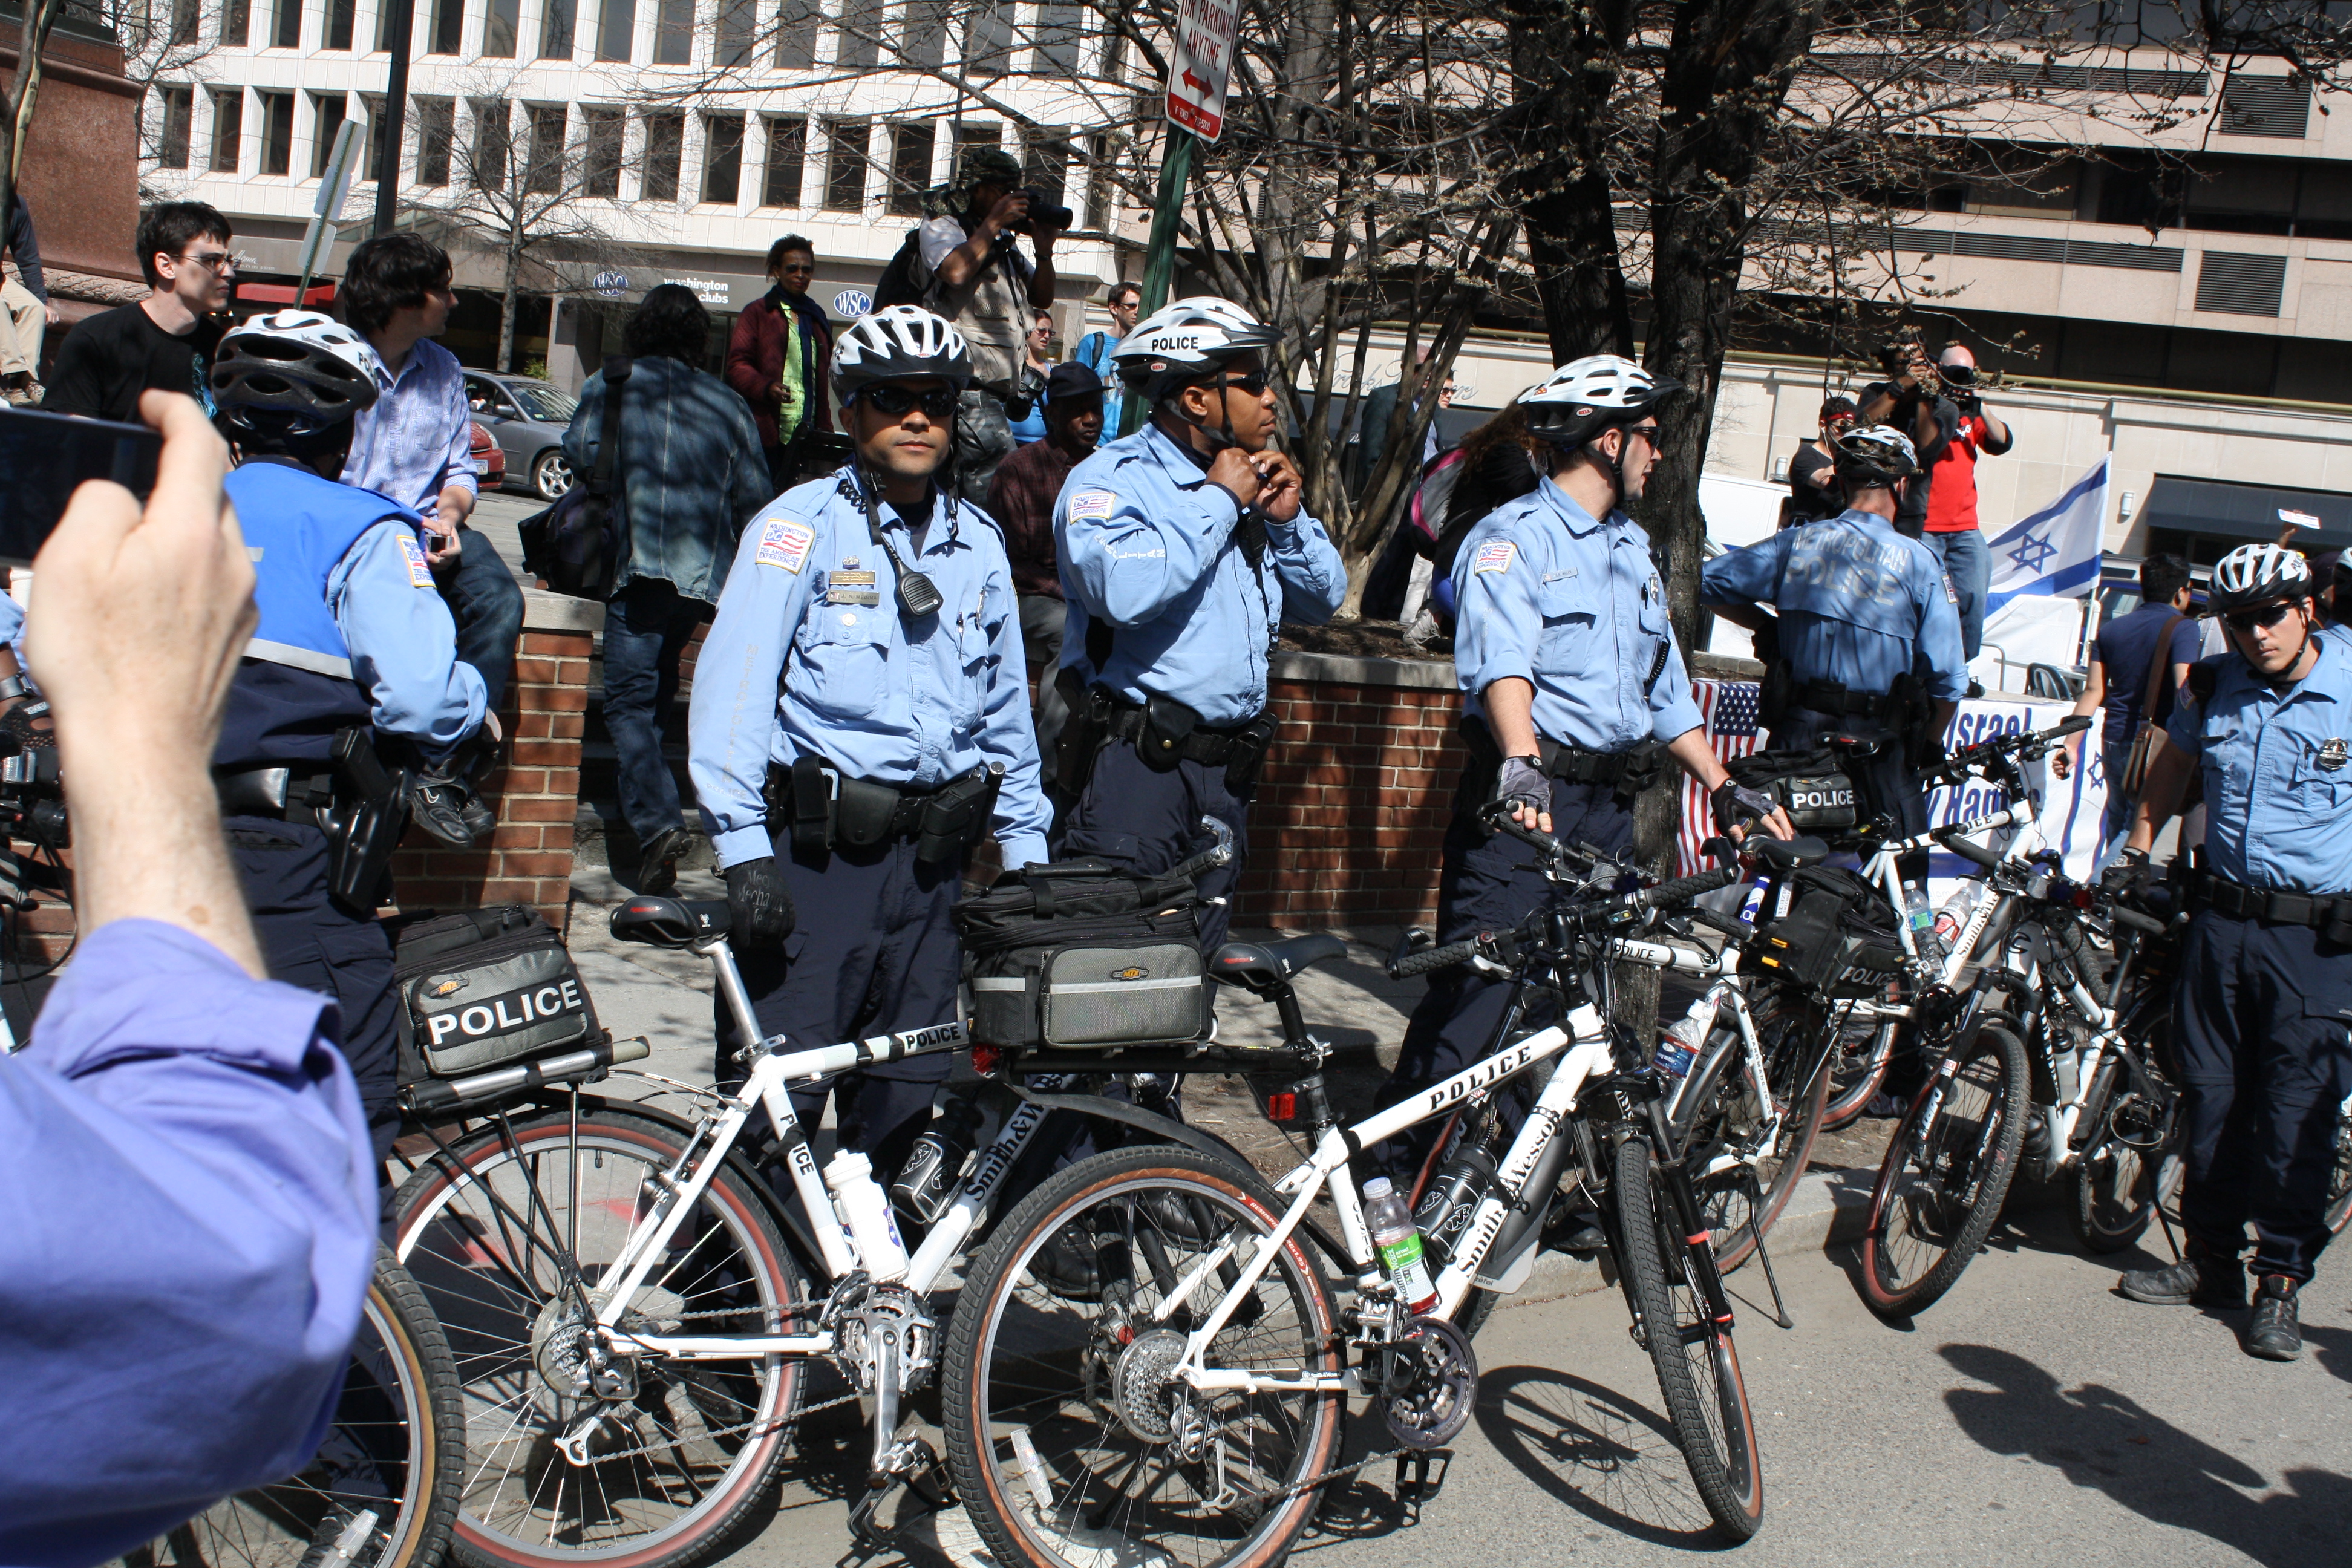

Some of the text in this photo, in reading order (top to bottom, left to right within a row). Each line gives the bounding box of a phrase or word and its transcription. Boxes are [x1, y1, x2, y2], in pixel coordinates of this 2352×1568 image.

[1198, 0, 1234, 41] PARKING
[1185, 27, 1222, 71] ANYTIME
[664, 277, 729, 292] washington
[698, 292, 729, 304] clubs
[837, 292, 867, 315] WSC
[1152, 336, 1199, 351] POLICE
[765, 530, 782, 541] DC
[769, 523, 809, 539] WASHINGTON
[758, 552, 797, 568] EXPERIENCE
[771, 549, 800, 561] AMERICAN
[1792, 526, 1911, 573] METROPOLITAN
[1785, 555, 1898, 606] POLICE
[721, 644, 760, 784] METROPOLITAN
[1945, 706, 2033, 756] Israel
[1791, 789, 1855, 809] POLICE
[1967, 816, 1993, 830] ICE
[1614, 944, 1656, 961] POLICE
[439, 981, 458, 993] MTX
[1840, 966, 1898, 987] POLICE
[427, 979, 582, 1045] POLICE
[905, 1025, 961, 1050] POLICE
[1749, 1033, 1765, 1087] HANDMADE
[1429, 1045, 1533, 1112] POLICE
[779, 1114, 815, 1177] PICE
[1249, 1201, 1280, 1229] HEMISPH
[1285, 1238, 1305, 1267] 26x1.95
